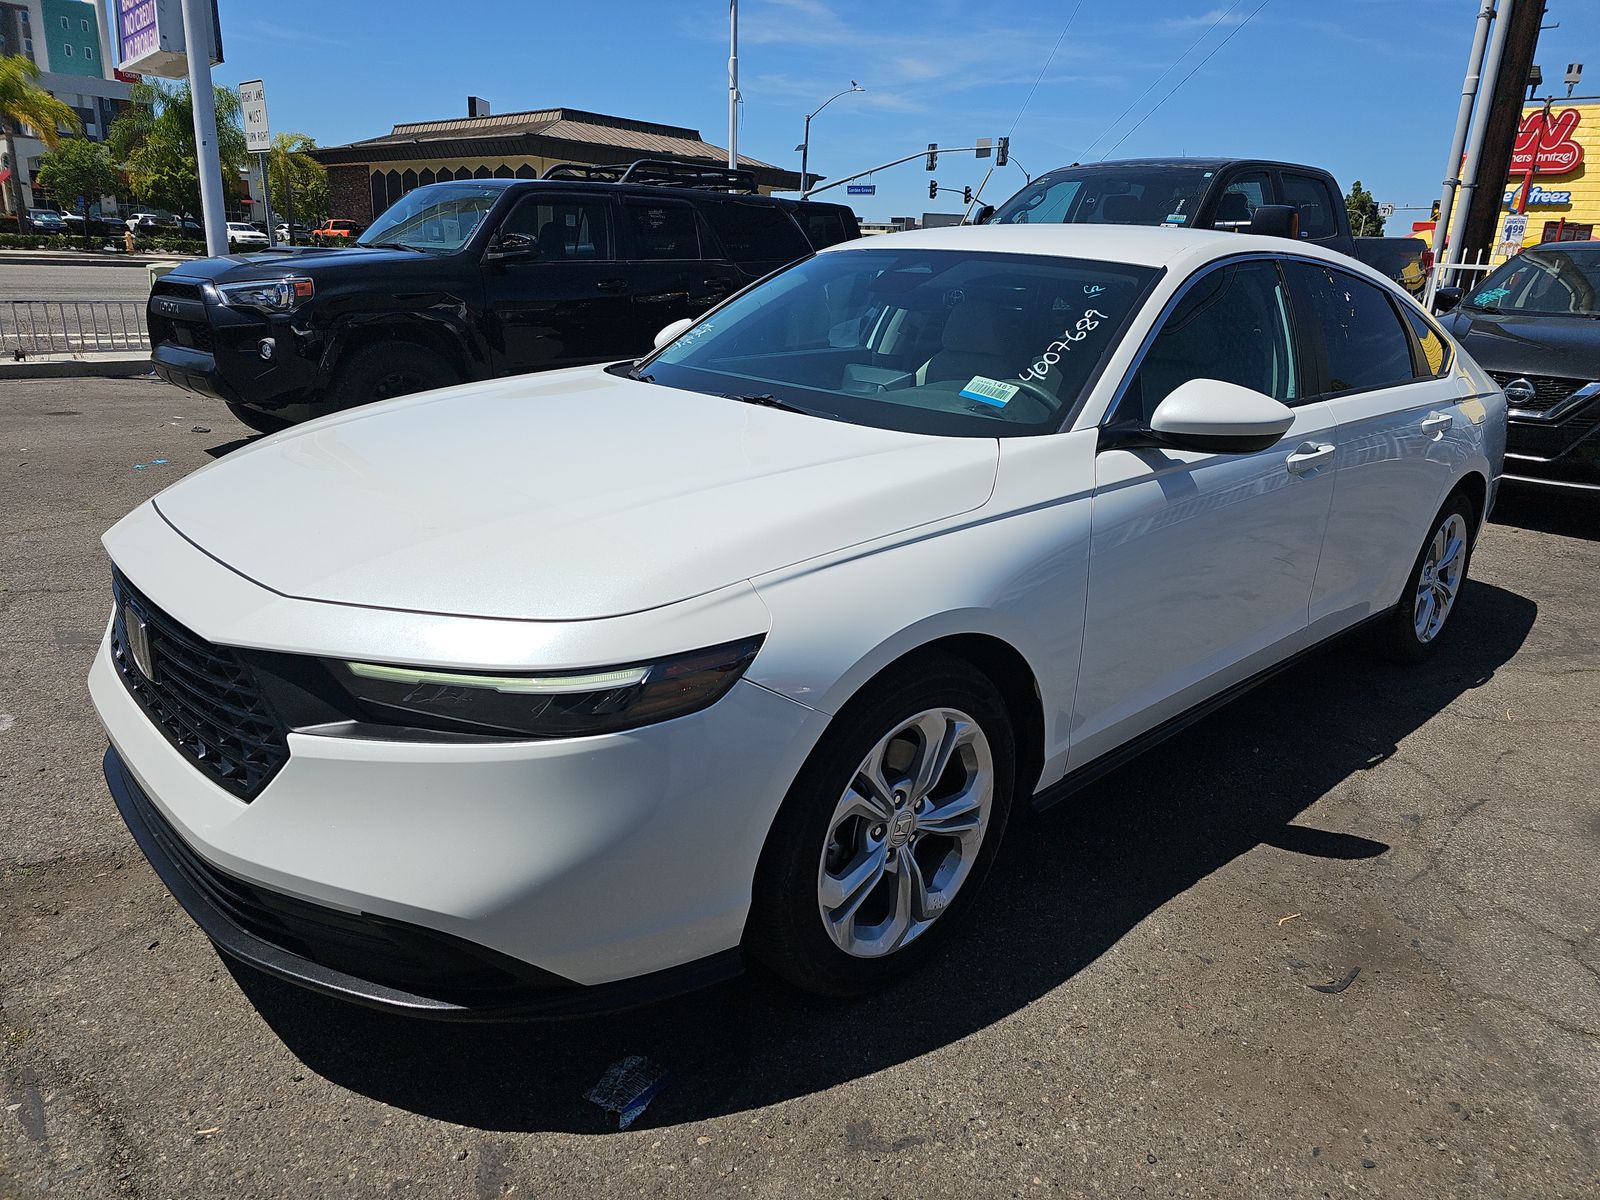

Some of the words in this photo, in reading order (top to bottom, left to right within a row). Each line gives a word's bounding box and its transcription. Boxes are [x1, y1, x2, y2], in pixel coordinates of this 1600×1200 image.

[125, 12, 135, 37] NO
[135, 0, 155, 31] CREDIT
[125, 39, 135, 62] NO
[241, 91, 252, 103] RIGHT
[253, 89, 264, 102] LANE
[248, 109, 262, 123] MUST
[246, 132, 257, 143] TURN
[257, 130, 269, 142] RIGHT
[1528, 187, 1570, 204] freez
[159, 301, 179, 313] TOYOTA
